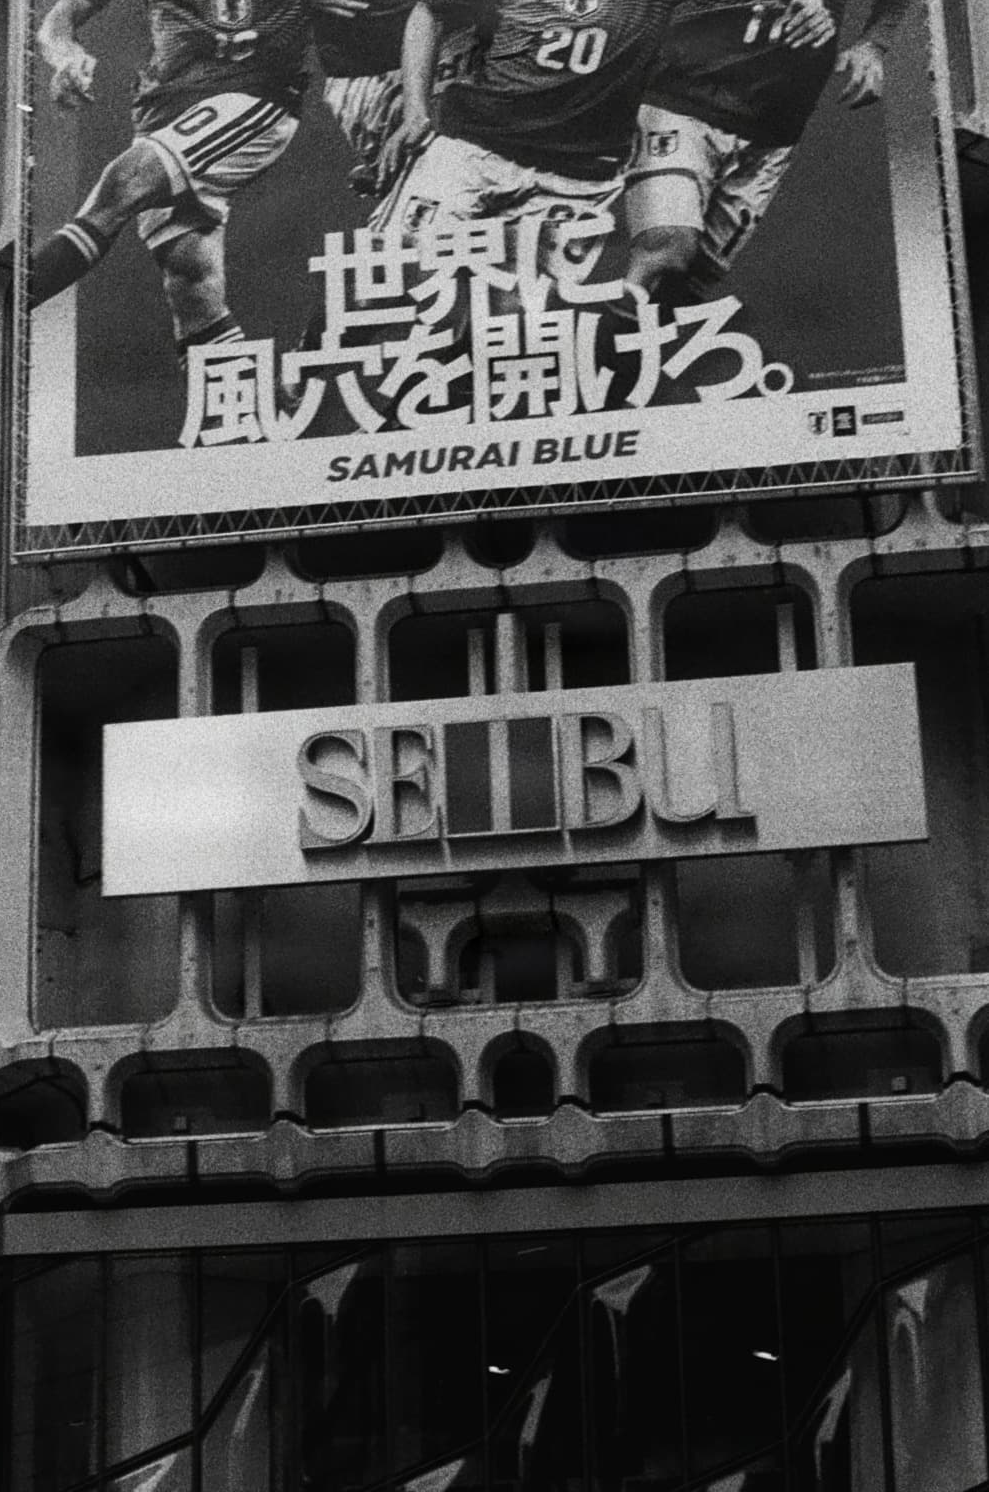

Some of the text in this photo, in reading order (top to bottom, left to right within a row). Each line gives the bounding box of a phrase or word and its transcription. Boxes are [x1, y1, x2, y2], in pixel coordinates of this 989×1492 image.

[535, 26, 609, 75] 20
[309, 211, 625, 335] 世界に
[179, 295, 795, 448] 風穴を開けろ。
[326, 429, 641, 483] SAMURAI BLUE
[297, 702, 757, 853] SEIBU
